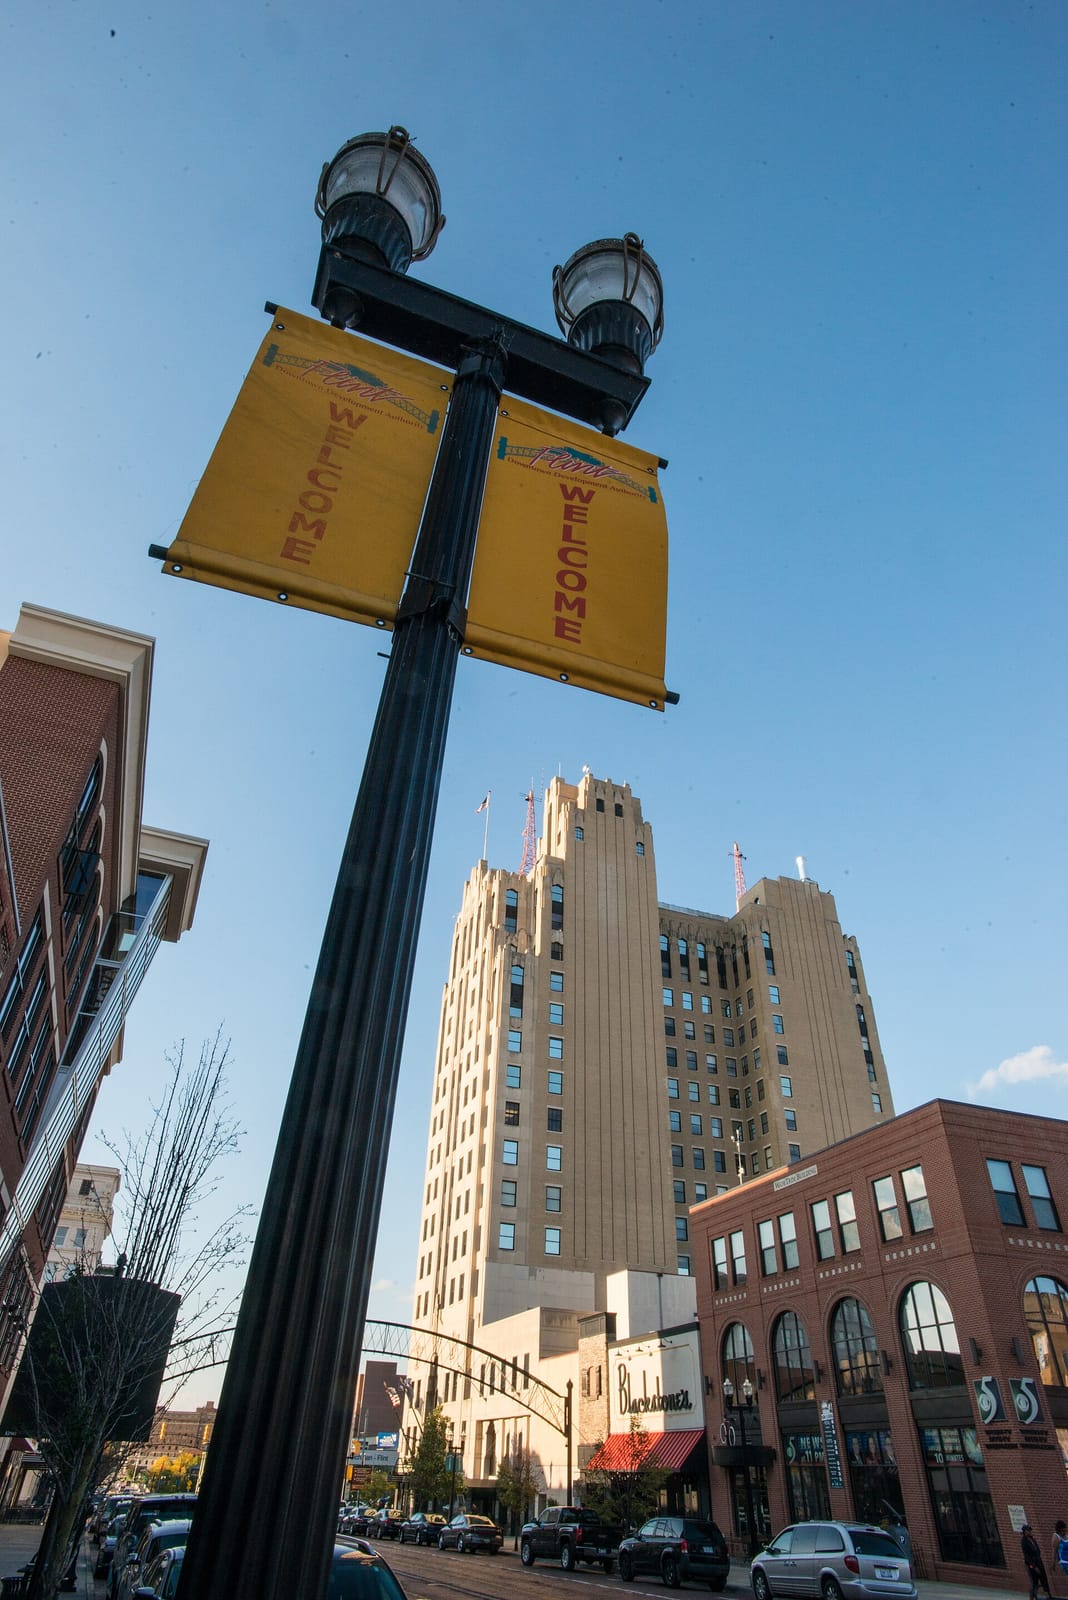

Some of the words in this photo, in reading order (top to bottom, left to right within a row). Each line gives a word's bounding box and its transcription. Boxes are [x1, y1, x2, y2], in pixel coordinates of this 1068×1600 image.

[274, 364, 324, 394] Downtown
[326, 388, 384, 415] Development
[385, 412, 425, 430] Authority
[301, 359, 415, 402] Flint
[280, 400, 368, 565] WELCOME
[507, 456, 552, 476] Downtown
[553, 471, 608, 490] Development
[609, 485, 647, 499] Authority
[529, 447, 632, 478] Flint
[554, 483, 596, 644] WELCOME
[934, 1452, 944, 1464] 10
